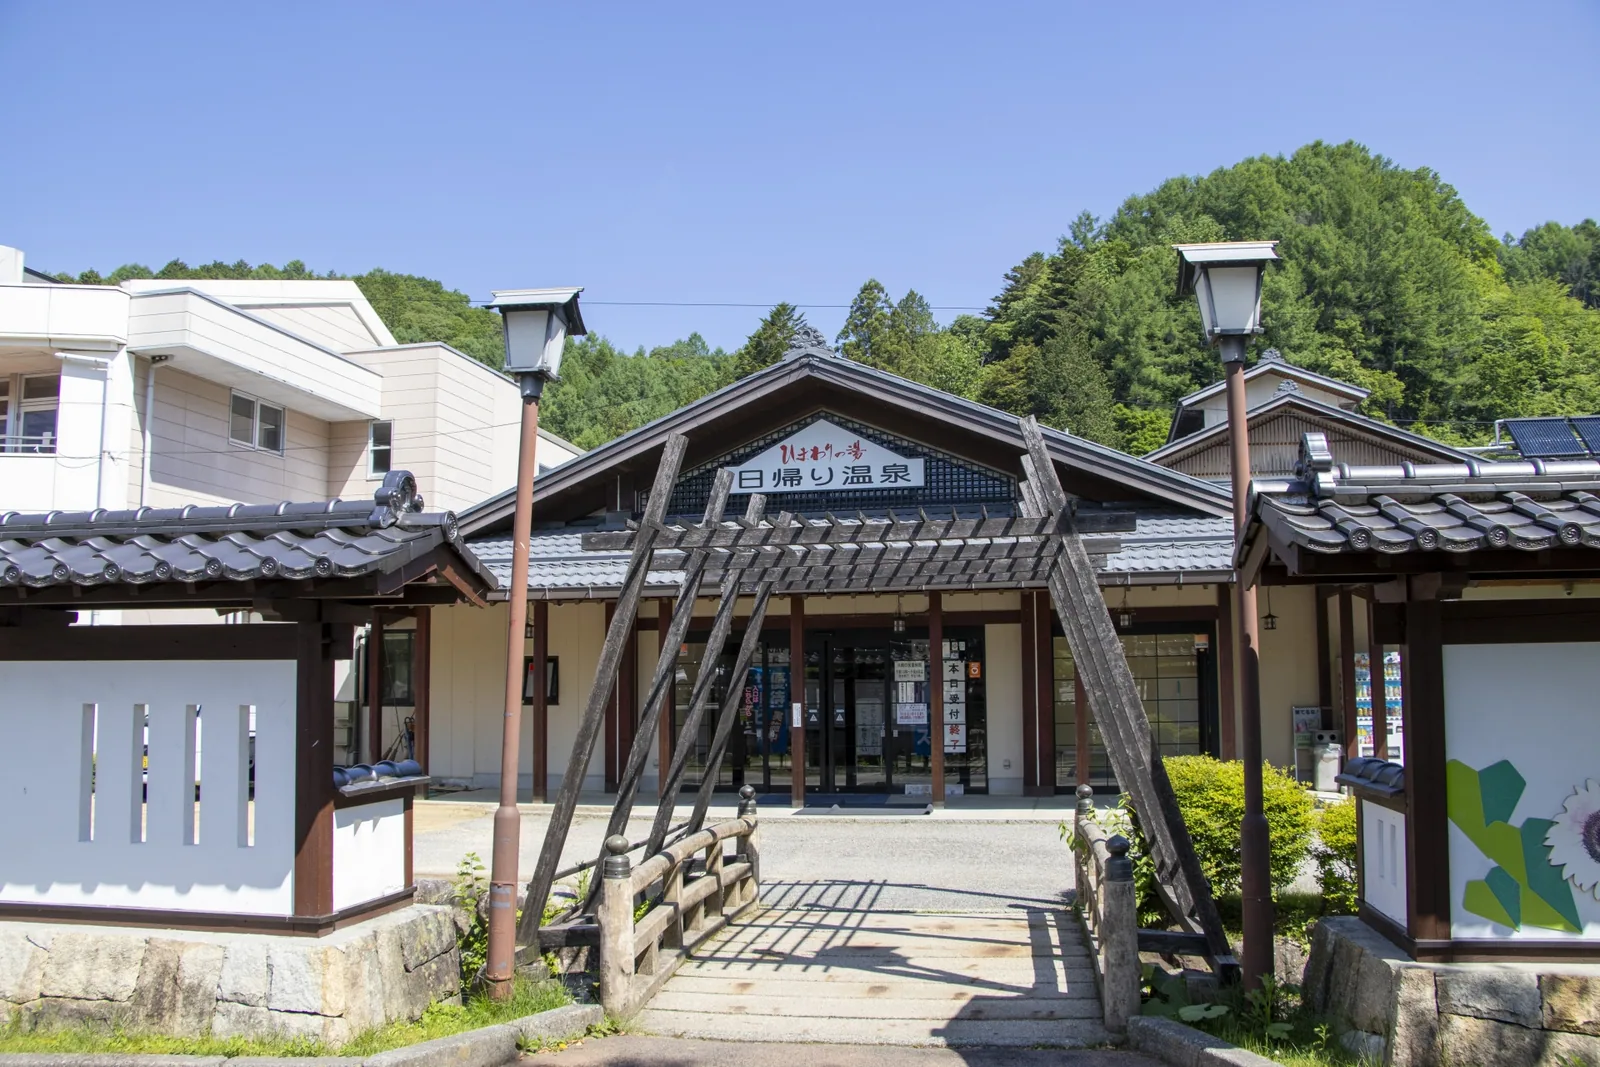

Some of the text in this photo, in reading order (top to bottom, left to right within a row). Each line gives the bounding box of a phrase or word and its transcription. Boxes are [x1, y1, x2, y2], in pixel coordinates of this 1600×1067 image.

[779, 439, 867, 465] ひまわりの湯
[738, 463, 912, 489] 日帰り温泉
[948, 662, 961, 750] 本日受付終了
